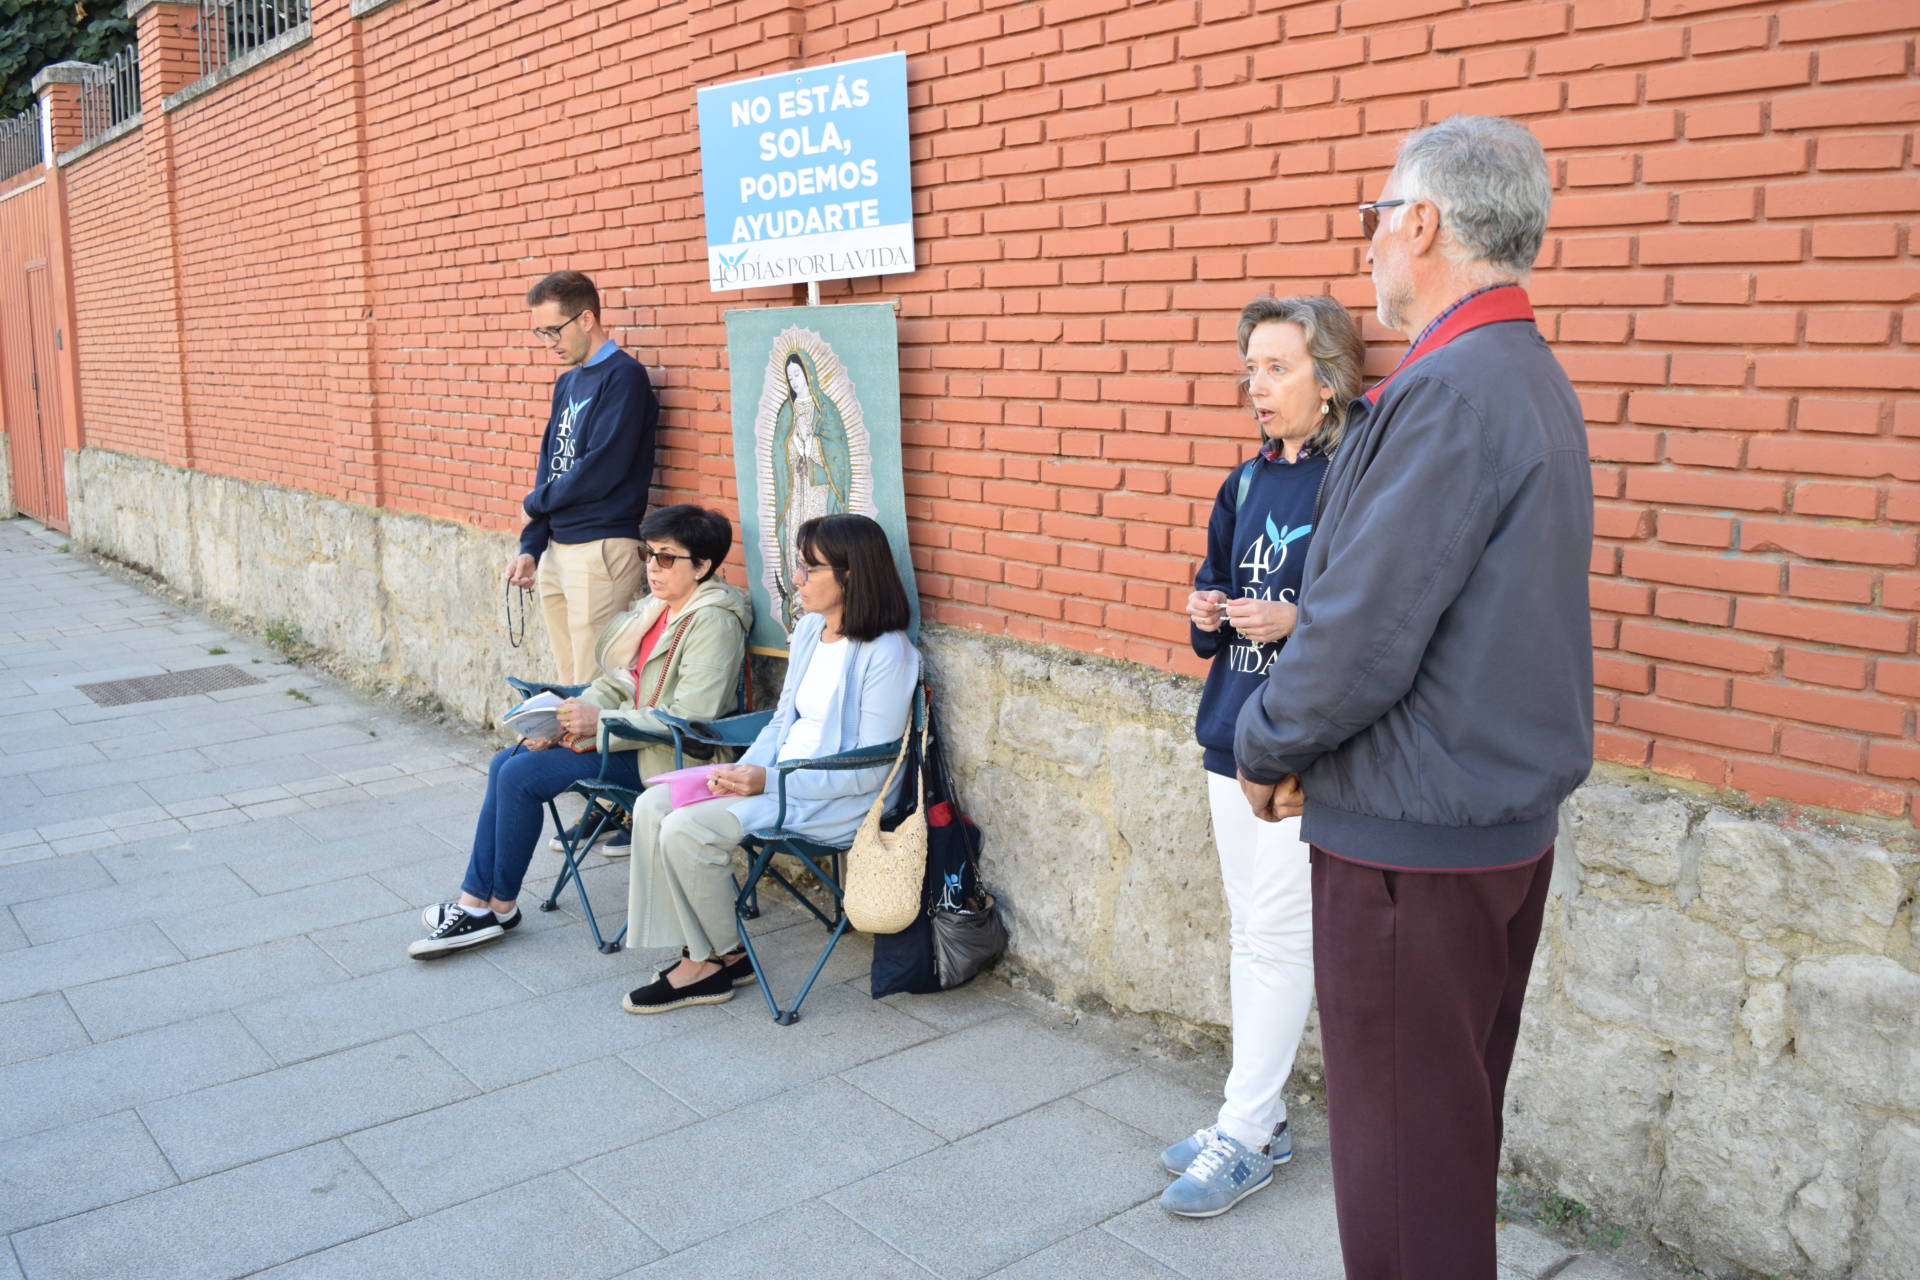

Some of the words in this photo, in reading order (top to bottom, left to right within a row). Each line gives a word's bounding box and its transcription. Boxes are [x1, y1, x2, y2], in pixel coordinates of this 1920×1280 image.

[731, 96, 771, 128] NO
[778, 74, 870, 120] ESTÁS
[759, 121, 852, 161] SOLA,
[740, 158, 879, 203] PODEMOS
[731, 199, 880, 243] AYUDARTE
[712, 263, 739, 288] 40
[742, 253, 785, 282] DÍAS
[787, 254, 826, 276] POR
[830, 251, 856, 272] LA
[854, 246, 911, 268] VIDA
[1239, 532, 1288, 584] 40
